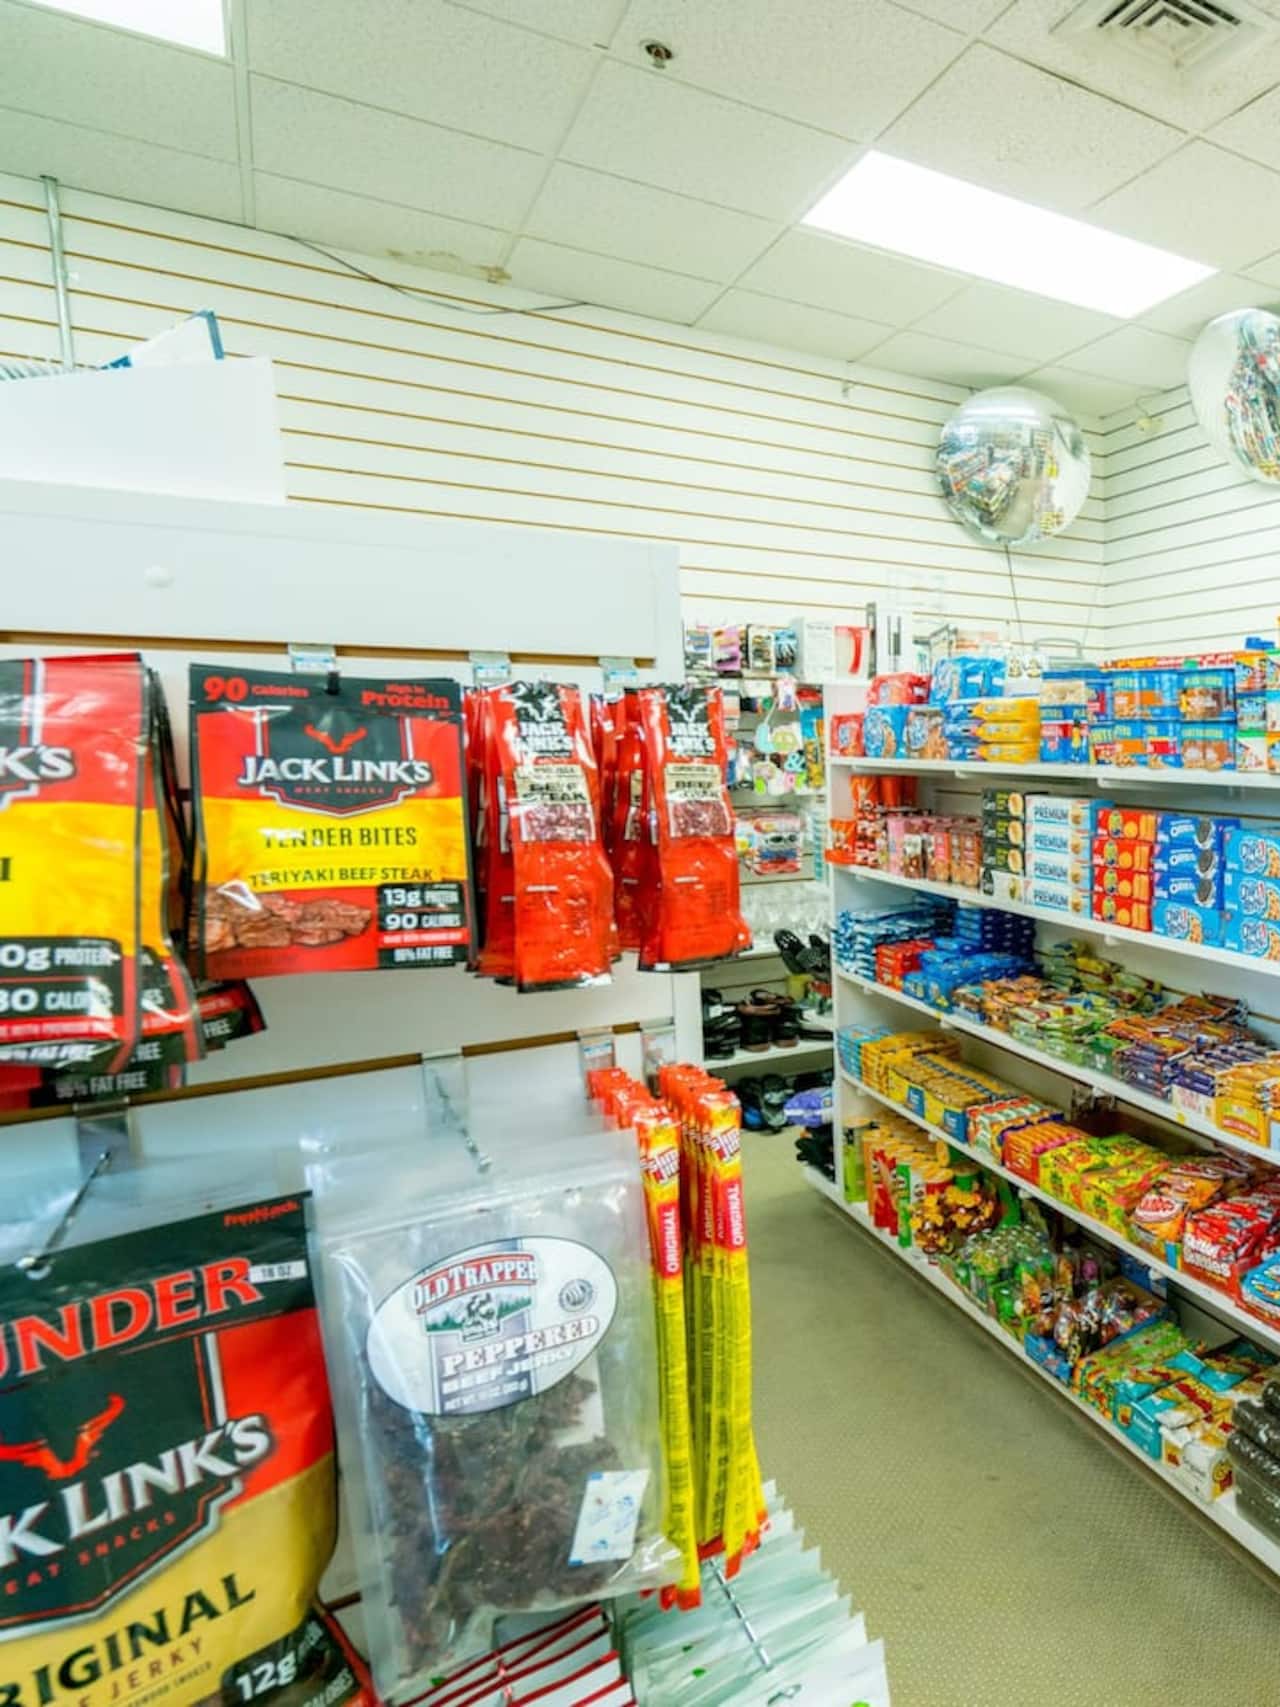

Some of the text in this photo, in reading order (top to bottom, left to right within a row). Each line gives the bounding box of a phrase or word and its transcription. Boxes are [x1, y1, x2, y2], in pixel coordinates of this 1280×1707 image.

[203, 676, 310, 702] 90 Calories
[361, 690, 450, 709] Protein
[238, 756, 432, 785] JACK LINK'S
[359, 826, 417, 846] BITES
[339, 867, 377, 881] BEEF
[381, 867, 433, 881] STEAK
[383, 888, 422, 907] 13g
[385, 913, 418, 931] 90
[0, 943, 50, 971] 0g
[117, 1071, 147, 1092] FREE
[727, 1181, 745, 1246] ORIGINAL
[663, 1208, 680, 1273] ORIGINAL
[441, 1316, 599, 1377] PEPPERED
[60, 1415, 271, 1540] LINK'S
[5, 1562, 60, 1595] EAT
[0, 1573, 256, 1707] RIGINAL
[111, 1638, 203, 1699] JERKY
[236, 1651, 298, 1701] 12g
